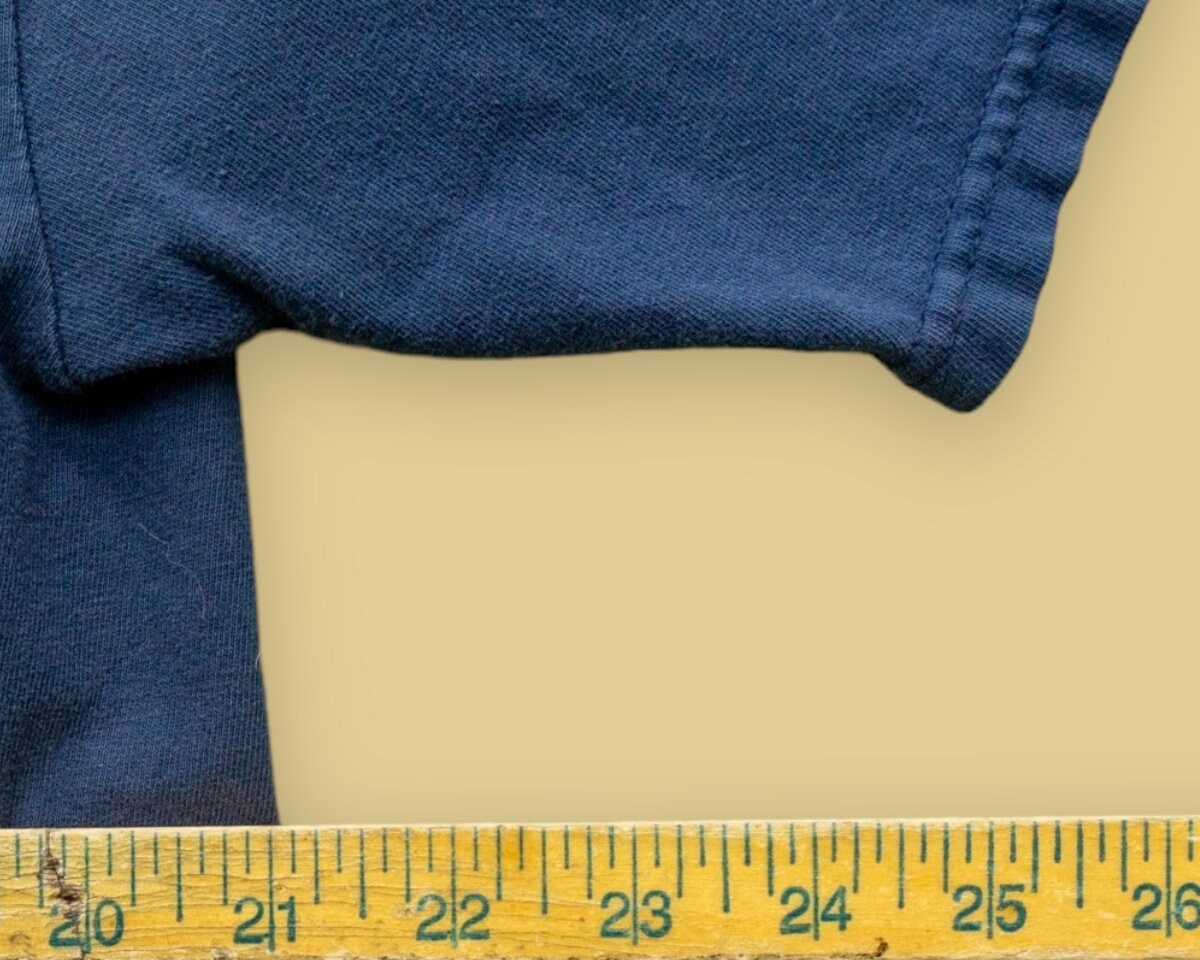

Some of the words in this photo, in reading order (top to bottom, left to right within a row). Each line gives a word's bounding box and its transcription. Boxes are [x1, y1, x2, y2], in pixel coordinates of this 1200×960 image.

[48, 898, 124, 947] 20
[233, 897, 297, 944] 21
[415, 893, 490, 941] 22
[600, 890, 673, 938] 23
[779, 885, 852, 935] 24
[952, 883, 1028, 933] 25
[1131, 882, 1200, 930] 26
